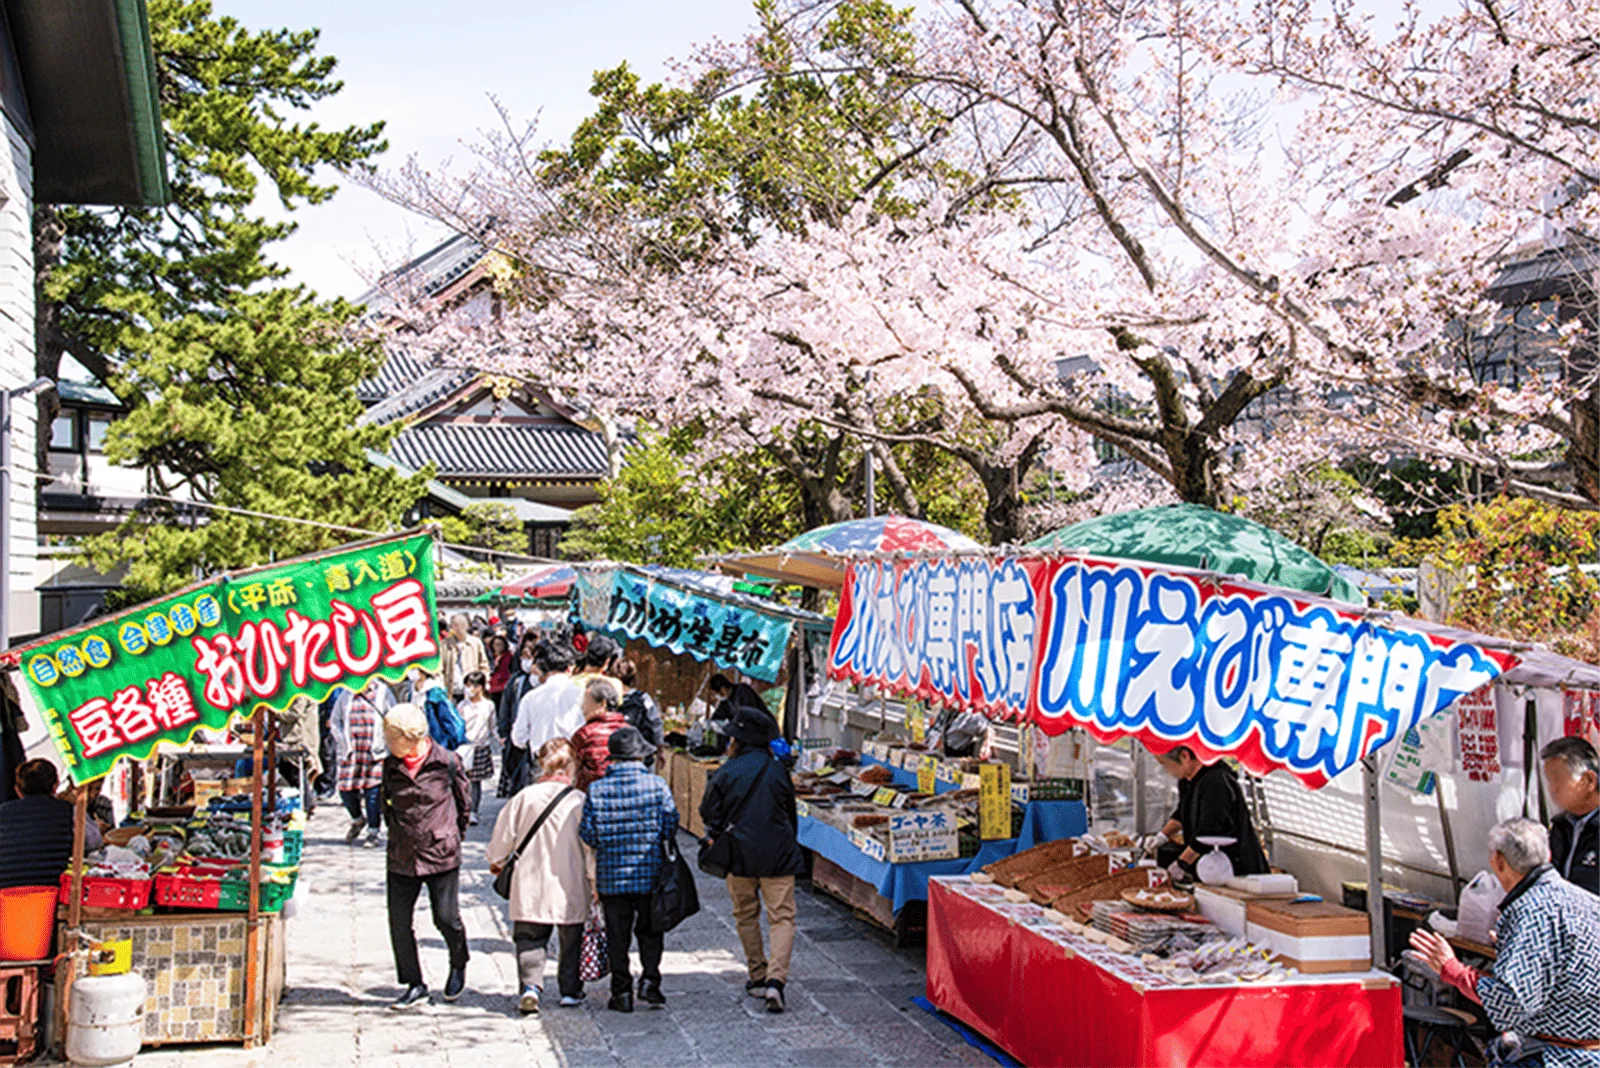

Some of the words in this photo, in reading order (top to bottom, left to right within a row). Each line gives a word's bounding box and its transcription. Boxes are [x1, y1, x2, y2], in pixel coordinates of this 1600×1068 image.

[193, 579, 438, 710] おひたし豆
[833, 557, 1034, 714] 川えび専門店
[68, 671, 199, 760] 豆各種
